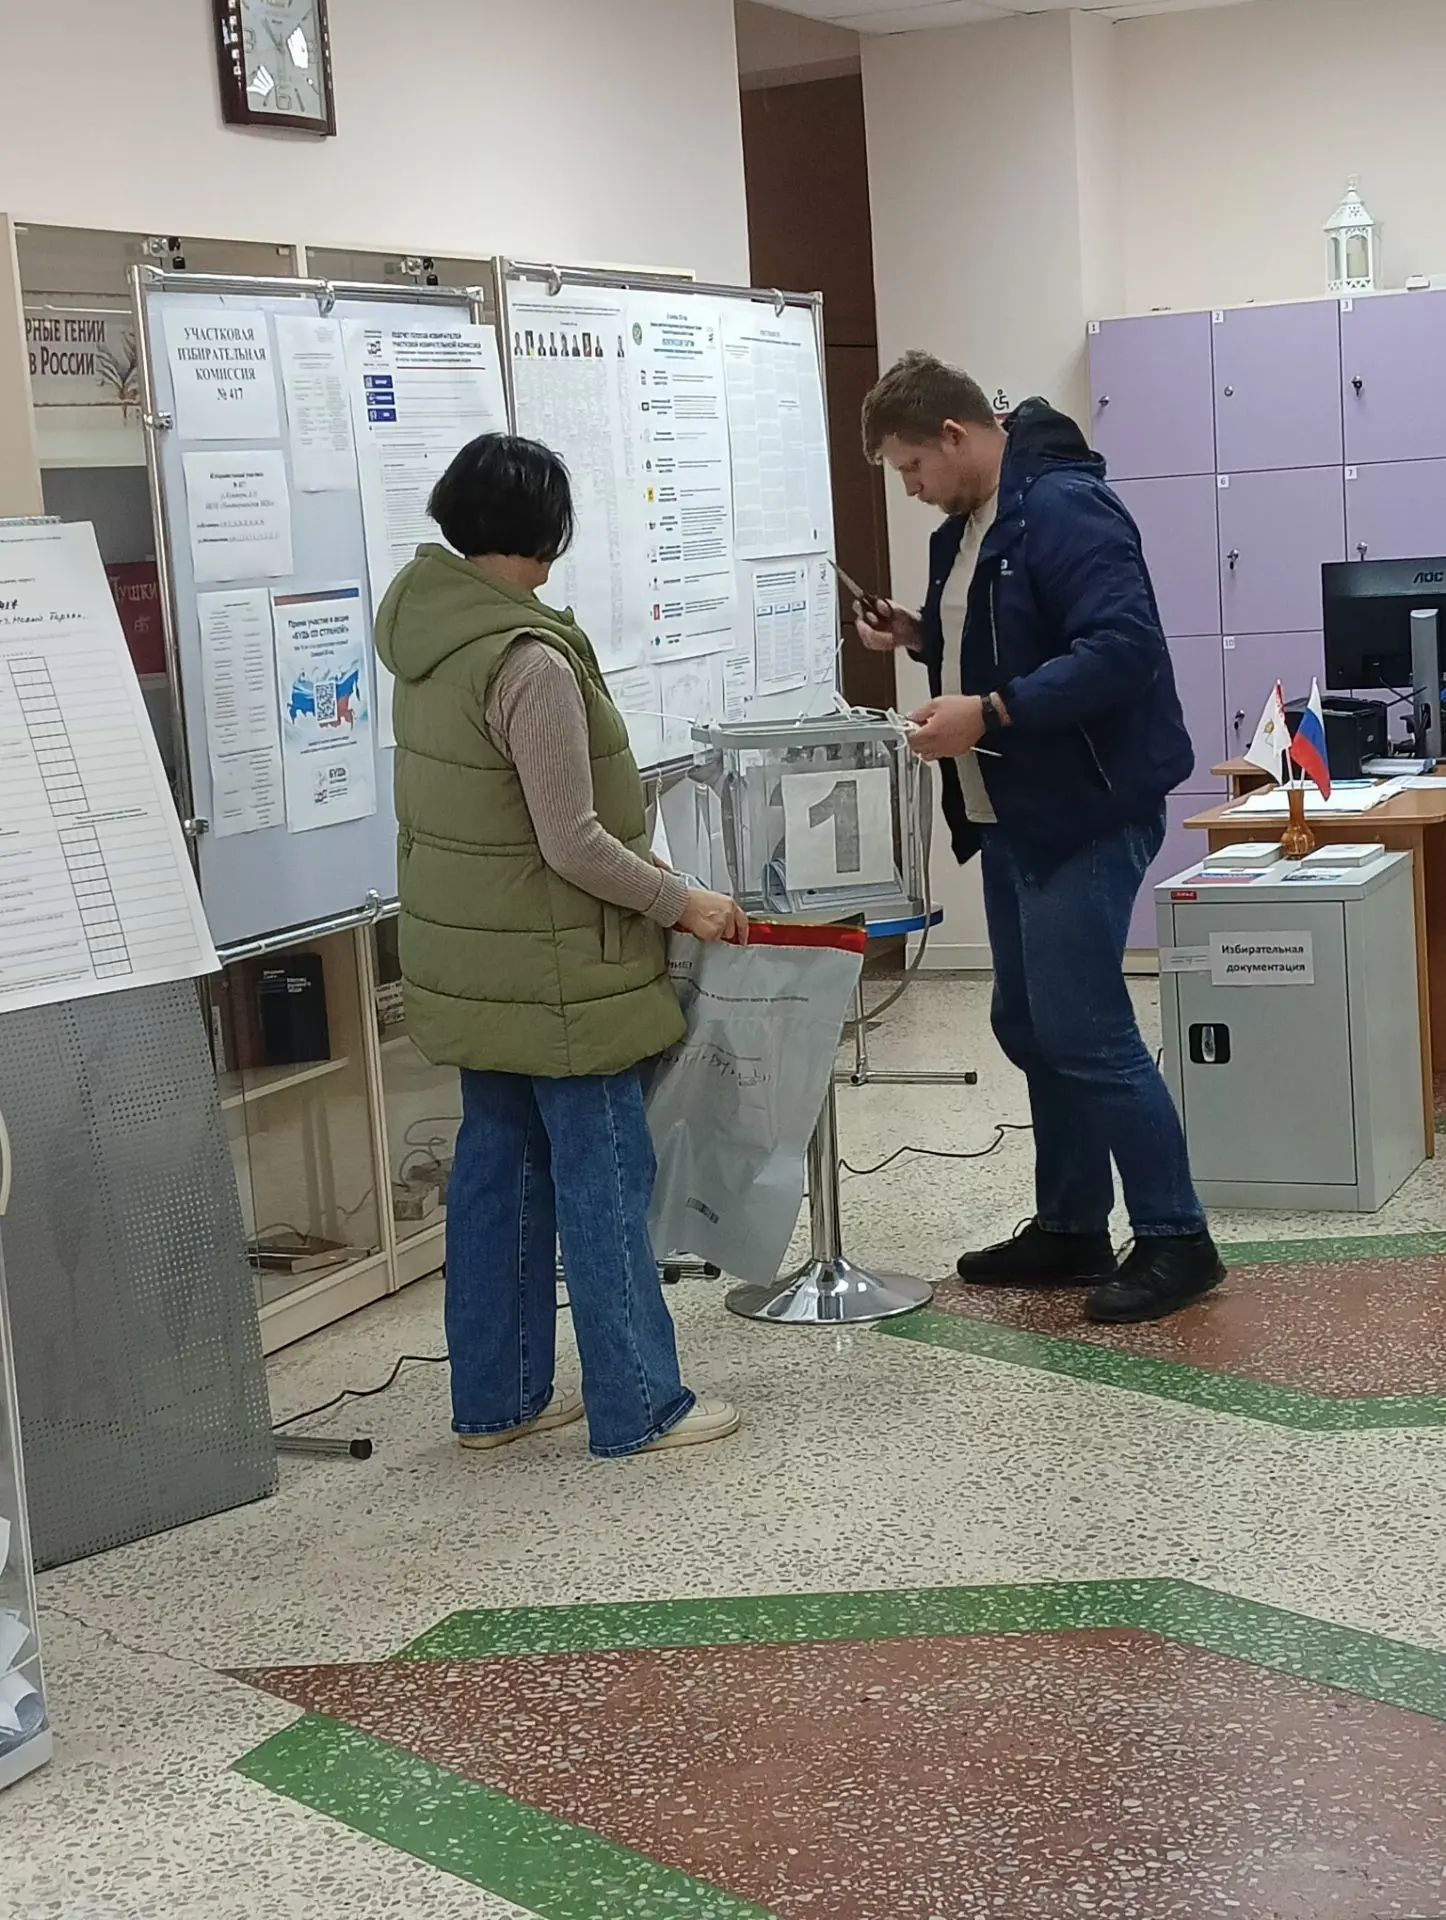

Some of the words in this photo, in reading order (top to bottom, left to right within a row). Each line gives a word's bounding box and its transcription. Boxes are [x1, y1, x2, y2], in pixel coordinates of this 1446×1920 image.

[64, 319, 105, 343] ГЕНИИ
[184, 327, 255, 341] УЧАСТКОВАЯ
[177, 347, 267, 361] ИЗБИРАТЕЛЬНАЯ
[195, 367, 256, 381] КОМИССИЯ
[217, 387, 227, 401] №
[229, 387, 243, 401] 417
[1413, 571, 1444, 585] AOC
[808, 780, 861, 874] 1
[1221, 944, 1304, 956] Избирательная
[1226, 962, 1305, 974] документация
